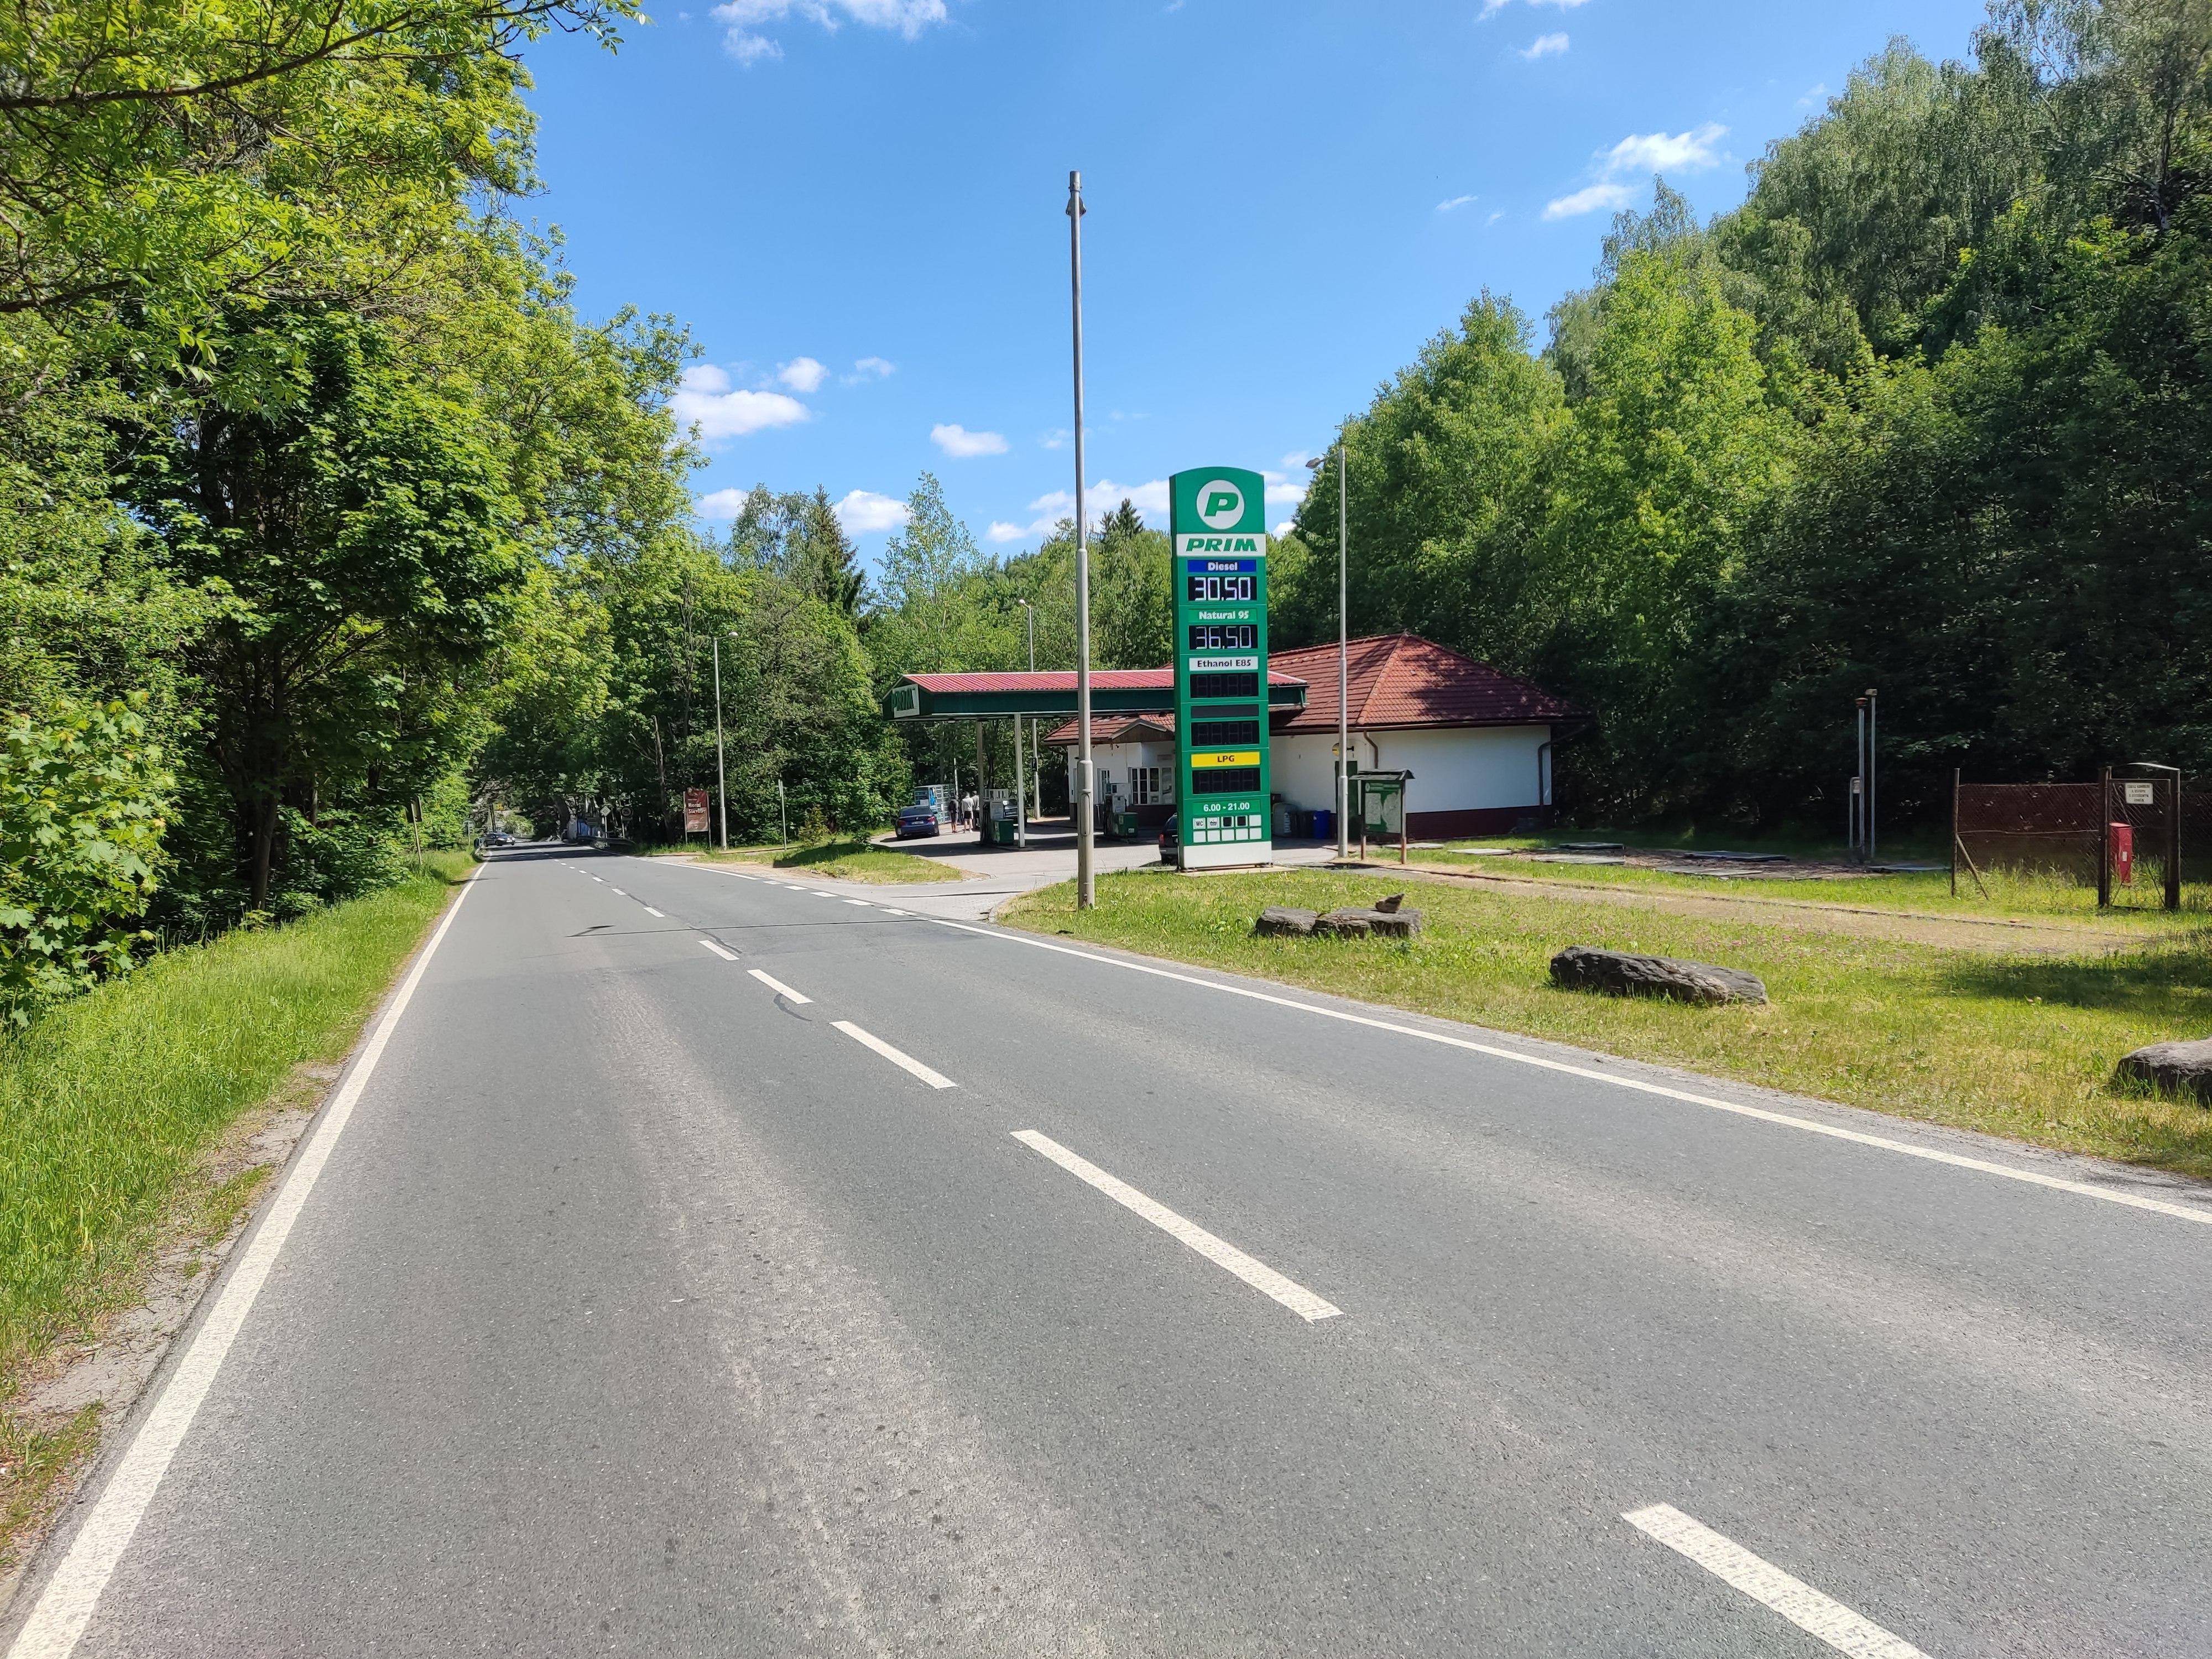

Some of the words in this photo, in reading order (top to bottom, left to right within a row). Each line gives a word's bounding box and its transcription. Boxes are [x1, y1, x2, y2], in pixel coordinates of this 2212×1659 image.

[1204, 492, 1239, 517] P
[1186, 538, 1258, 551] PRIM
[1208, 562, 1238, 571] Diesel
[1199, 611, 1236, 619] Natural
[1238, 610, 1249, 619] 95
[891, 688, 914, 712] PRIM
[1228, 802, 1250, 811] 21.00
